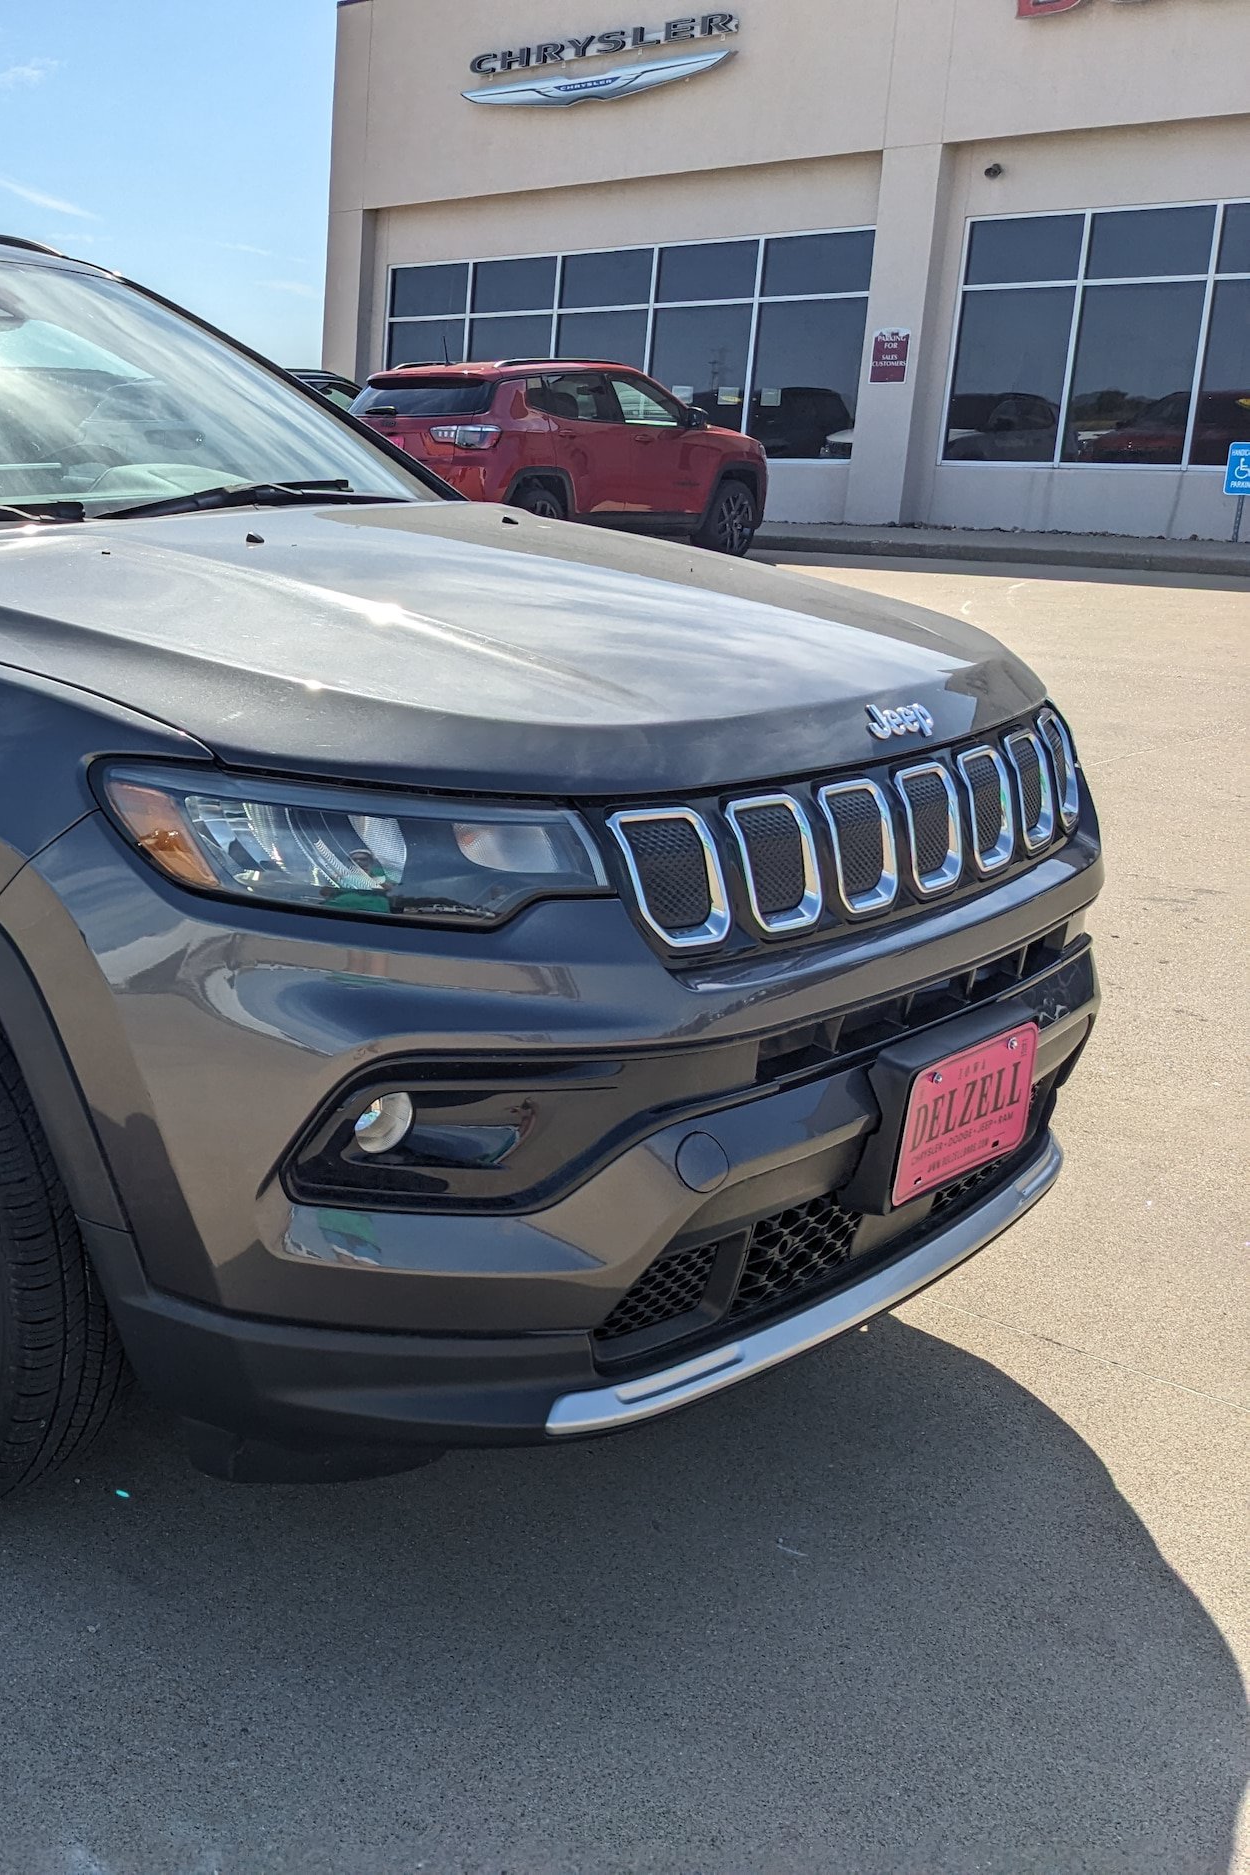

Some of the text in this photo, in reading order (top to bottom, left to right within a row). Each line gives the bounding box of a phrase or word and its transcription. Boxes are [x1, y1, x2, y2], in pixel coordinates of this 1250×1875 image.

[470, 12, 736, 75] CHRYSLER
[559, 79, 613, 91] CHRYSLER
[864, 703, 934, 739] Jeep
[958, 1059, 987, 1080] IOWA
[909, 1061, 1022, 1153] DELZELL
[910, 1111, 1014, 1166] CHRYSLER DODGE JEEP RAM
